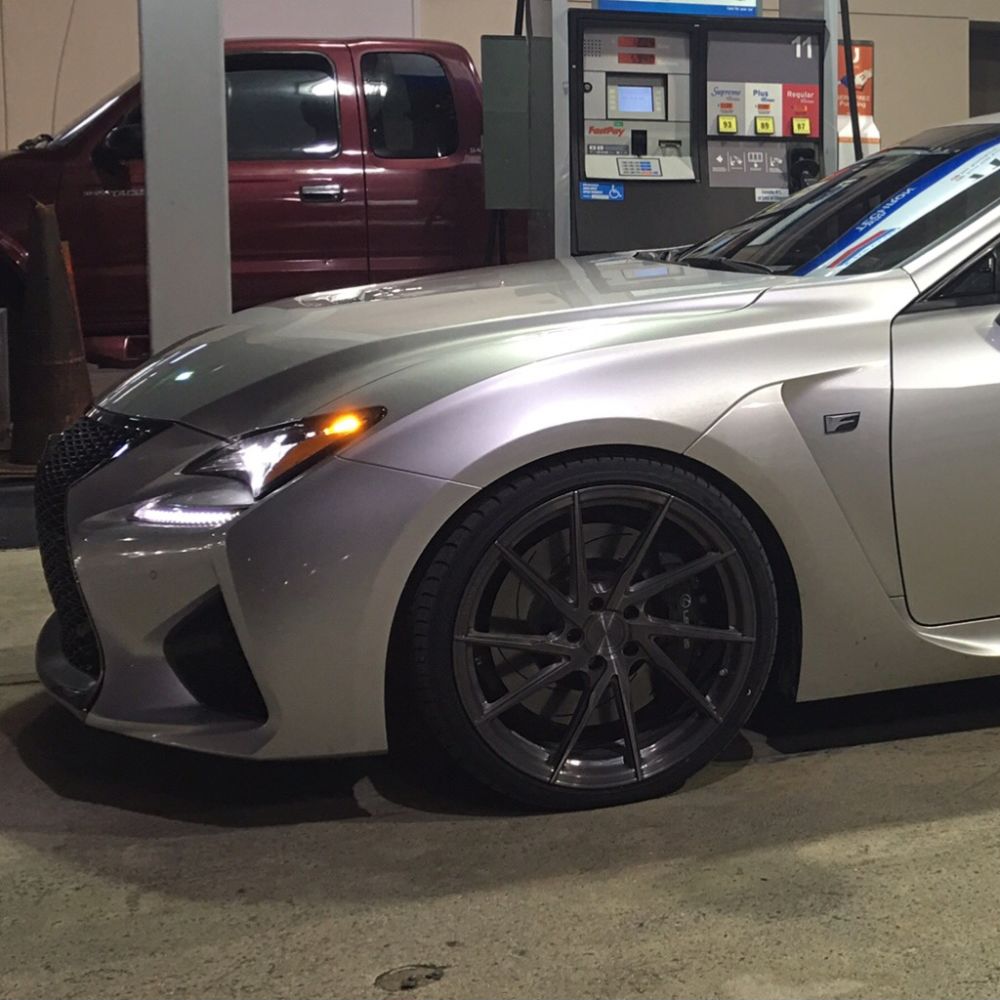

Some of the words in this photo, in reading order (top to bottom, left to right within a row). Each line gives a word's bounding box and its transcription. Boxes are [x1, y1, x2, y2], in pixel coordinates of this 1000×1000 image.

[791, 35, 812, 58] 11
[711, 86, 741, 97] Supreme
[753, 89, 768, 97] Plus
[787, 91, 814, 99] Regular
